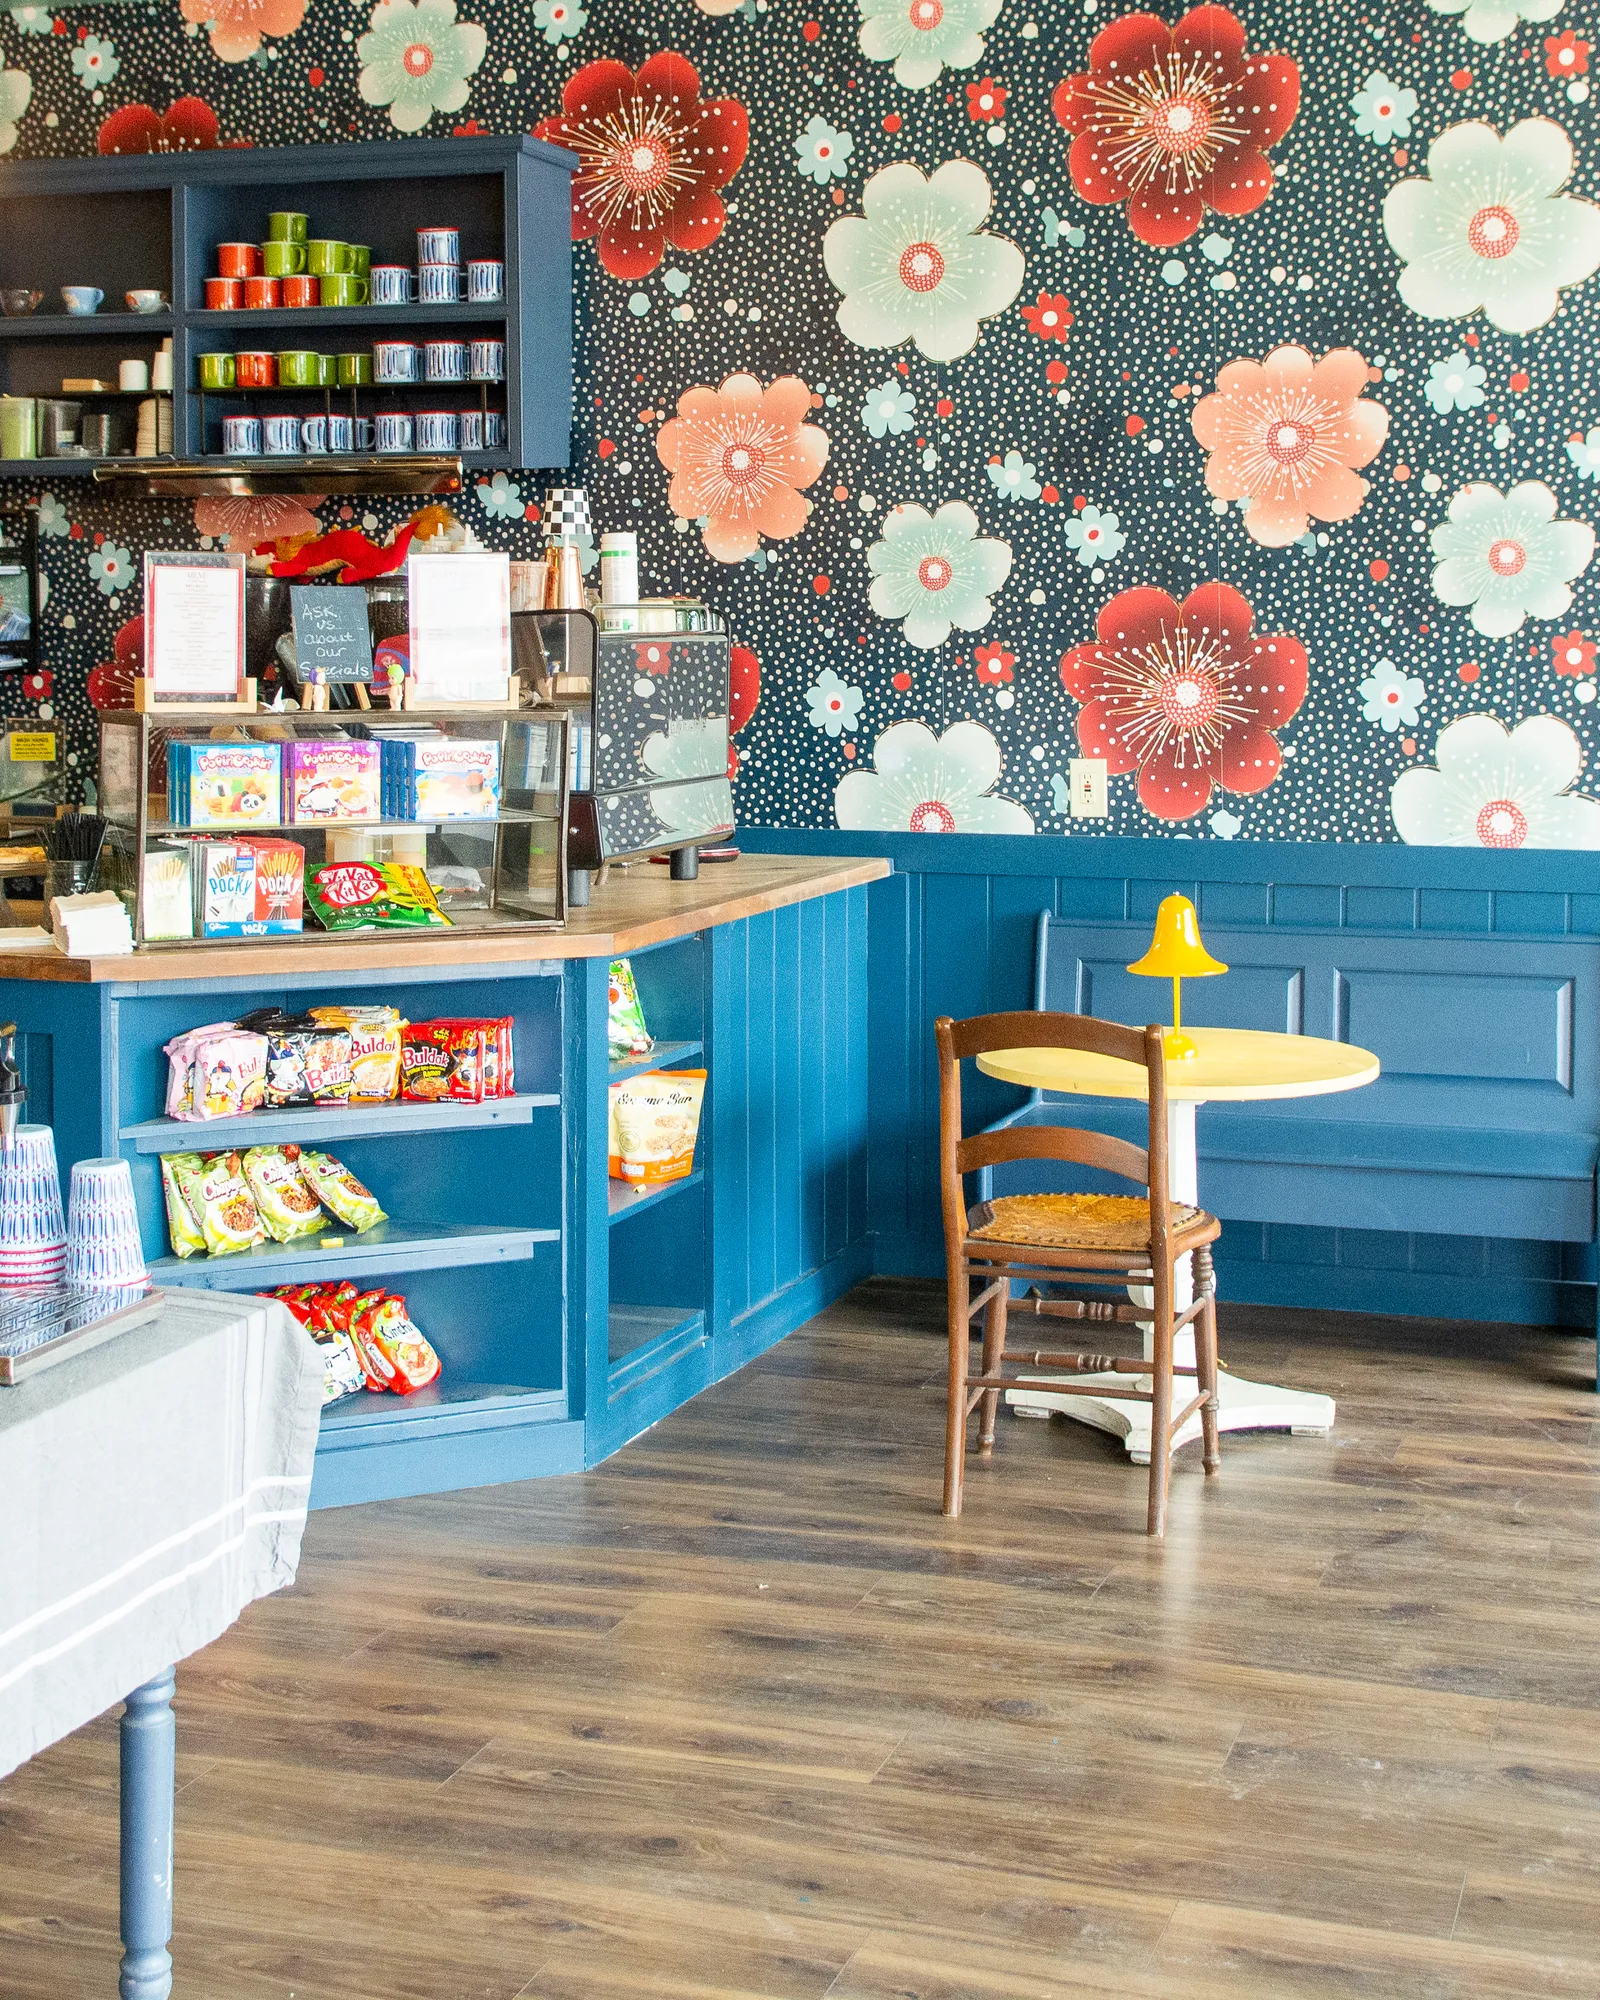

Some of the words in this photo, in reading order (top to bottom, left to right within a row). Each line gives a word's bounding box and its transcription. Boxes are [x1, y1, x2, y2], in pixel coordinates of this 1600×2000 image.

[304, 632, 357, 645] about
[315, 647, 347, 657] our
[300, 660, 369, 677] Secials
[402, 1047, 449, 1069] Buldak
[667, 1092, 693, 1106] Bar
